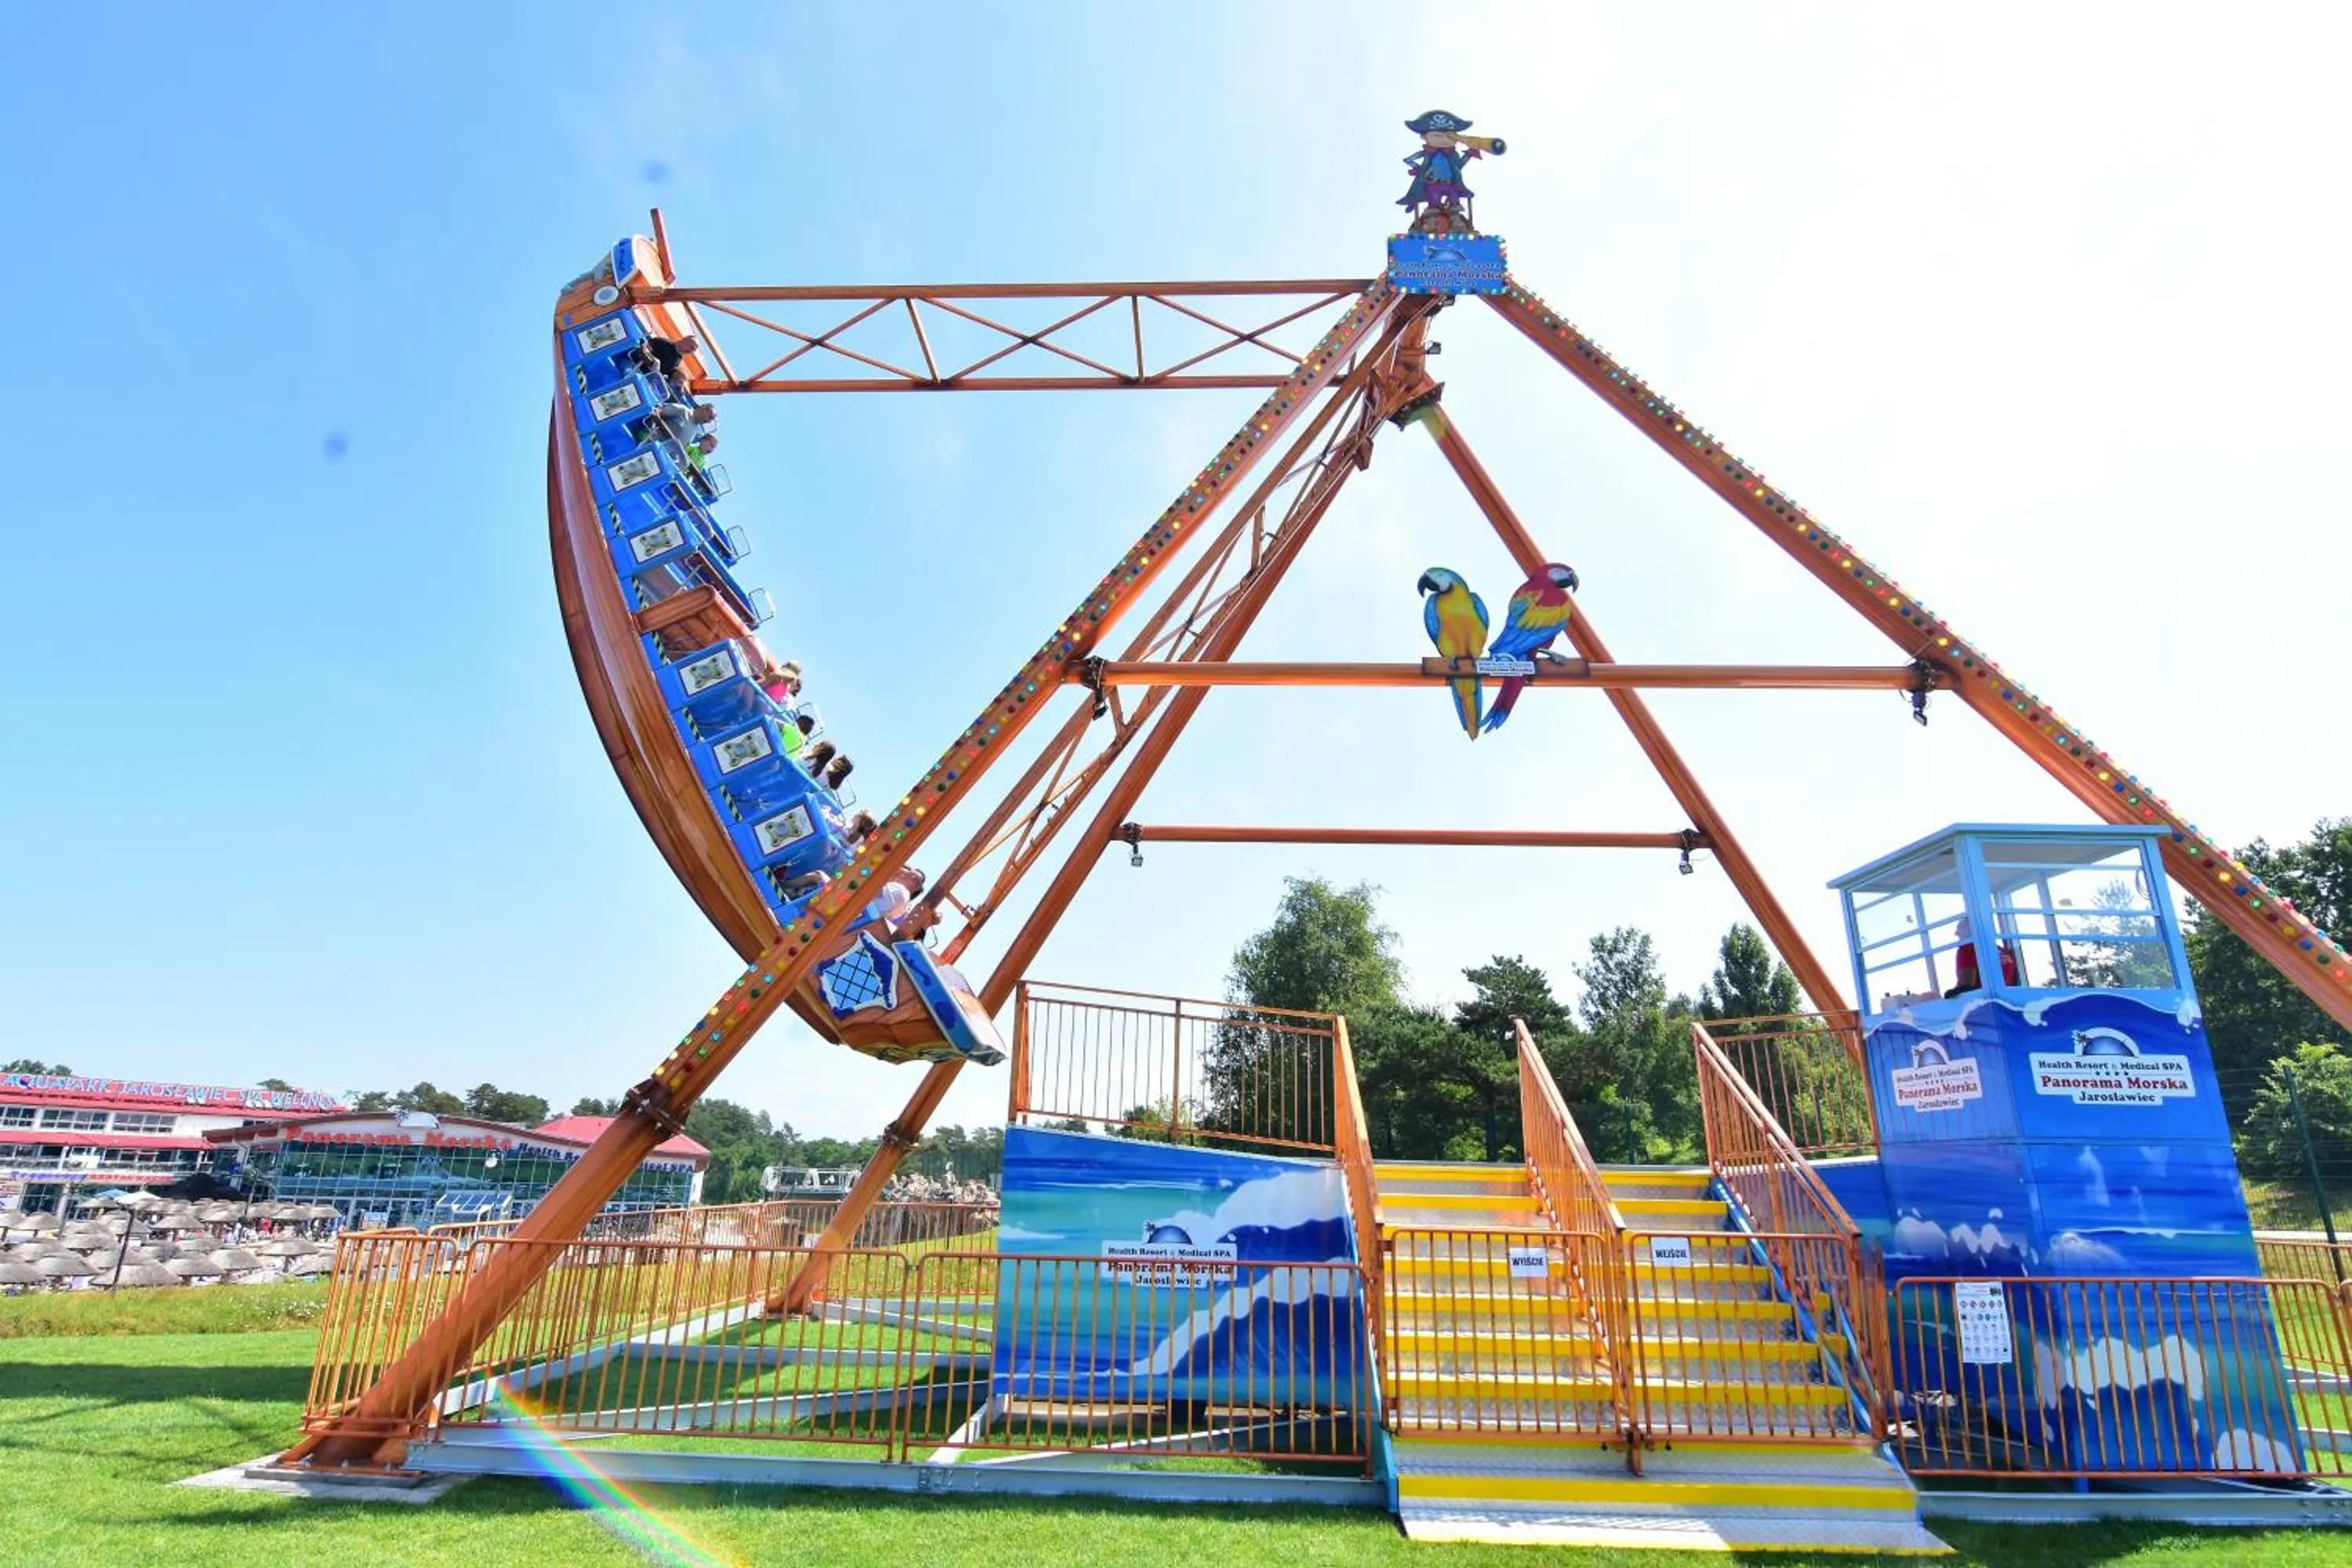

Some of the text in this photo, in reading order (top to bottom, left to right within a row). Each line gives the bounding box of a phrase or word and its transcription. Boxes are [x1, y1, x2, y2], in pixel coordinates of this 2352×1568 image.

[2038, 1061, 2072, 1069] Health
[2074, 1061, 2108, 1070] Resort
[2120, 1062, 2159, 1071] Medical
[2162, 1062, 2183, 1072] SPA
[5, 1073, 110, 1093] AQUAPARK
[2041, 1075, 2188, 1091] Panorama Morska
[1898, 1082, 1978, 1100] Panorama Morska
[2078, 1091, 2155, 1102] Jarosławiec
[285, 1126, 512, 1149] Panorama Morska
[518, 1142, 561, 1159] Health
[670, 1162, 695, 1173] SPA
[1178, 1248, 1211, 1257] Medical
[1655, 1248, 1688, 1258] WEJŚCIE
[1108, 1259, 1232, 1274] Panorm Morka
[1135, 1274, 1202, 1286] Jarosłwic
